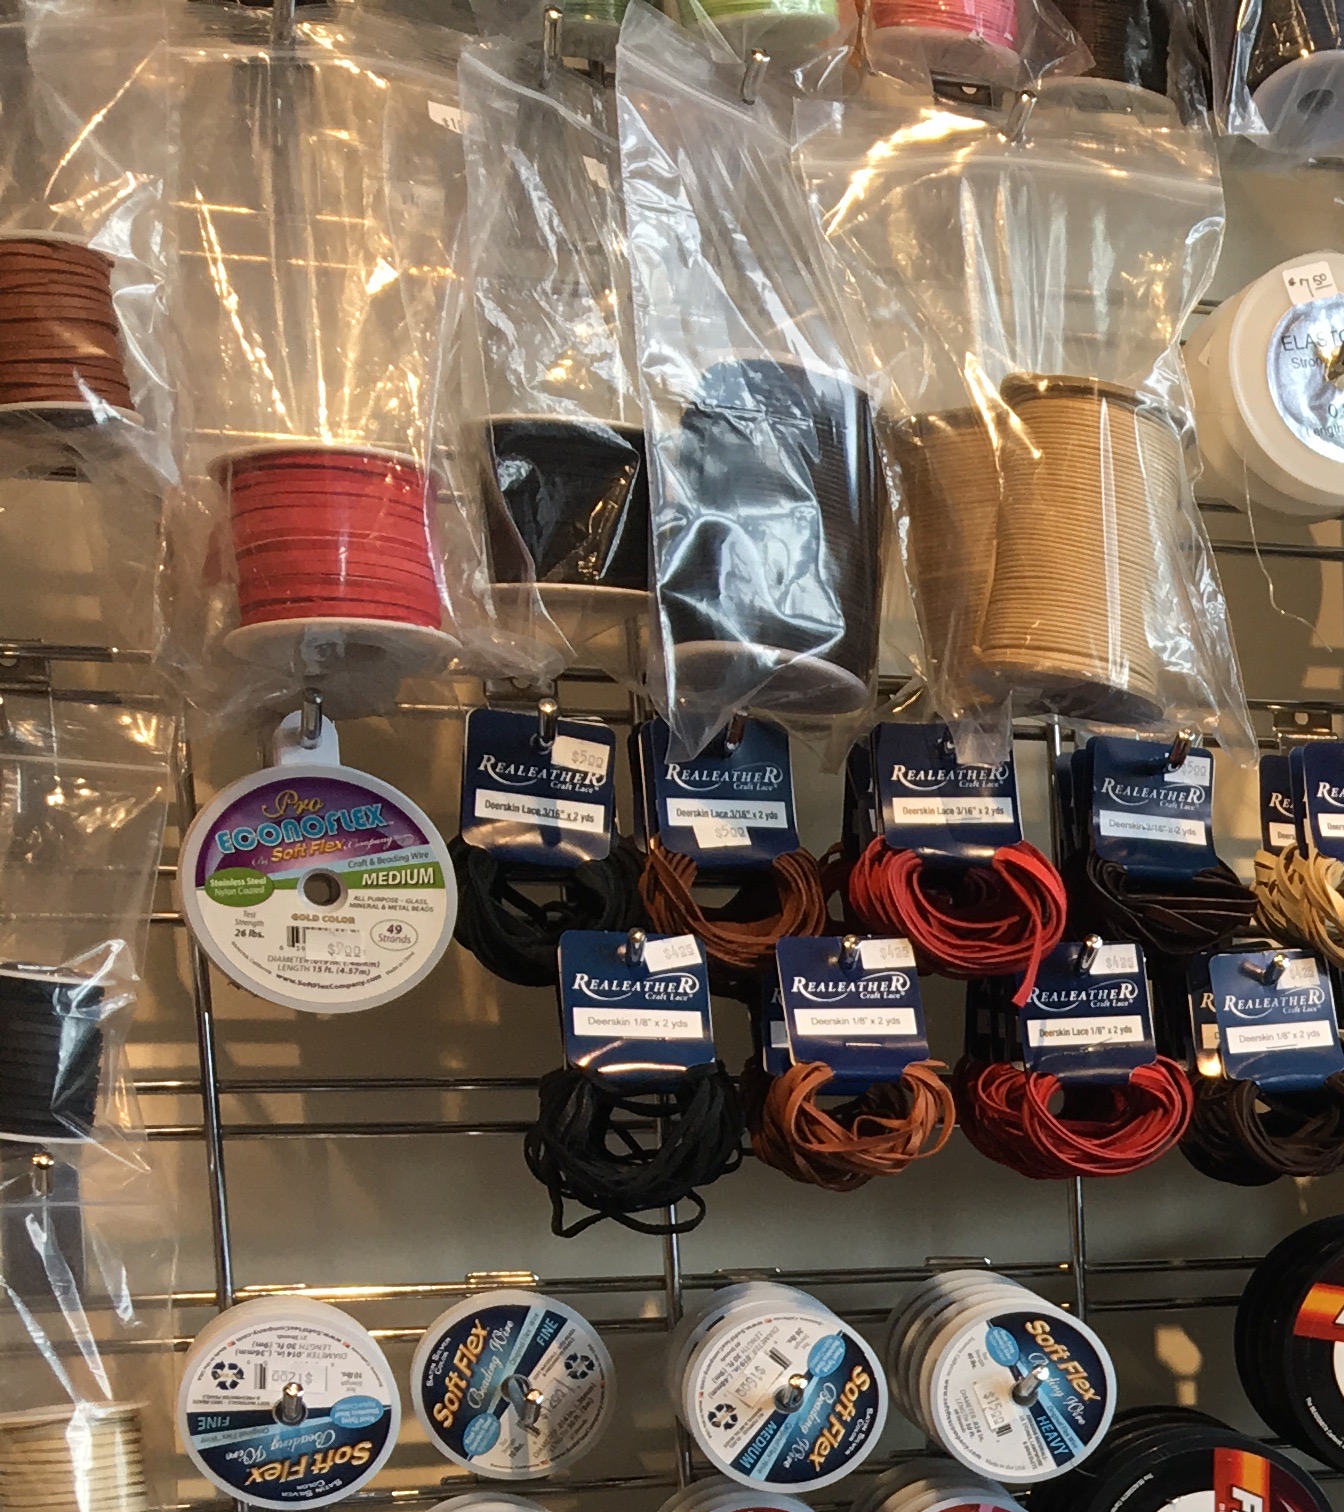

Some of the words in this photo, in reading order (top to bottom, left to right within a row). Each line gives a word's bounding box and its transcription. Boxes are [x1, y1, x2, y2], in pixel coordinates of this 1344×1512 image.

[262, 789, 324, 819] Pro
[215, 803, 387, 854] ECONOFLEX
[271, 843, 308, 862] Soft
[310, 839, 345, 857] Flex
[348, 858, 369, 869] Craft
[377, 853, 410, 867] Beading
[411, 850, 430, 861] Wire
[209, 876, 245, 888] Stainless
[247, 876, 267, 887] Steel
[362, 867, 435, 886] MEDIUM
[291, 913, 320, 923] GOLD
[322, 914, 356, 924] COLOR
[234, 928, 247, 938] 26
[249, 928, 265, 939] lbs.
[377, 933, 412, 945] Strands
[386, 924, 403, 935] 49
[572, 973, 700, 1001] REALEATHER
[588, 1016, 631, 1028] Deerskin
[661, 1018, 669, 1028] 2
[672, 1018, 688, 1031] yds
[536, 1318, 559, 1347] FINE
[433, 1376, 466, 1429] Soft
[457, 1319, 491, 1377] Flex
